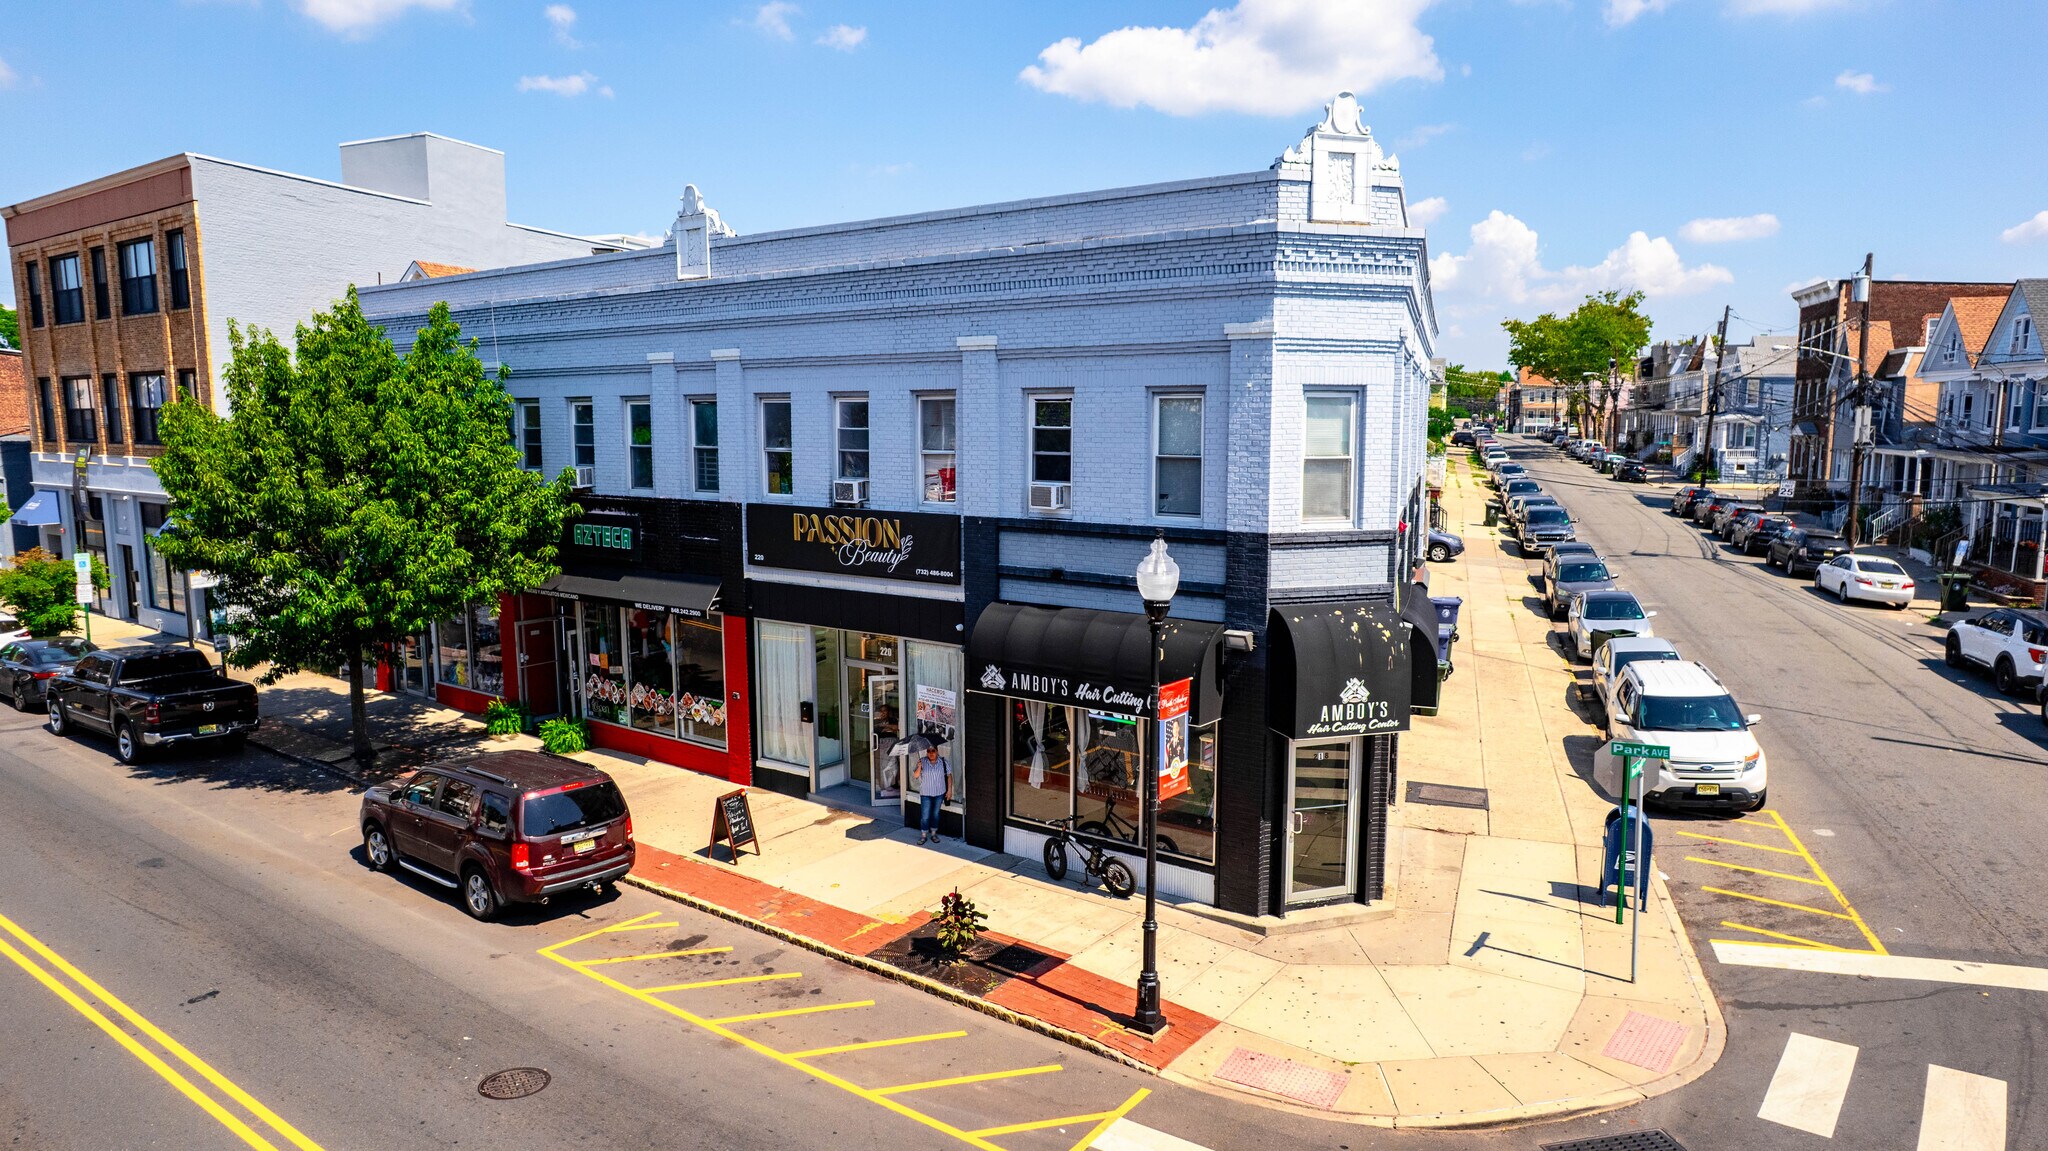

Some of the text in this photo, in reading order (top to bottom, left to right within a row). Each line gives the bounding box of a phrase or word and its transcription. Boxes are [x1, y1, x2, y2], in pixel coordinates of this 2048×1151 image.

[1780, 488, 1793, 496] 25
[574, 523, 632, 550] AZTECA
[793, 512, 900, 549] PASSION
[838, 538, 902, 573] Beauty
[915, 568, 929, 576] (732)
[643, 603, 665, 612] DELIVERY
[880, 646, 892, 657] 220
[1011, 672, 1068, 696] AMBOY'S
[1074, 682, 1101, 701] Hair
[1102, 685, 1144, 714] Cutting
[1320, 701, 1388, 722] AMBOY'S
[1307, 719, 1400, 734] Hair Cutting Center
[1313, 752, 1329, 760] 218
[1612, 744, 1669, 758] Park AVE
